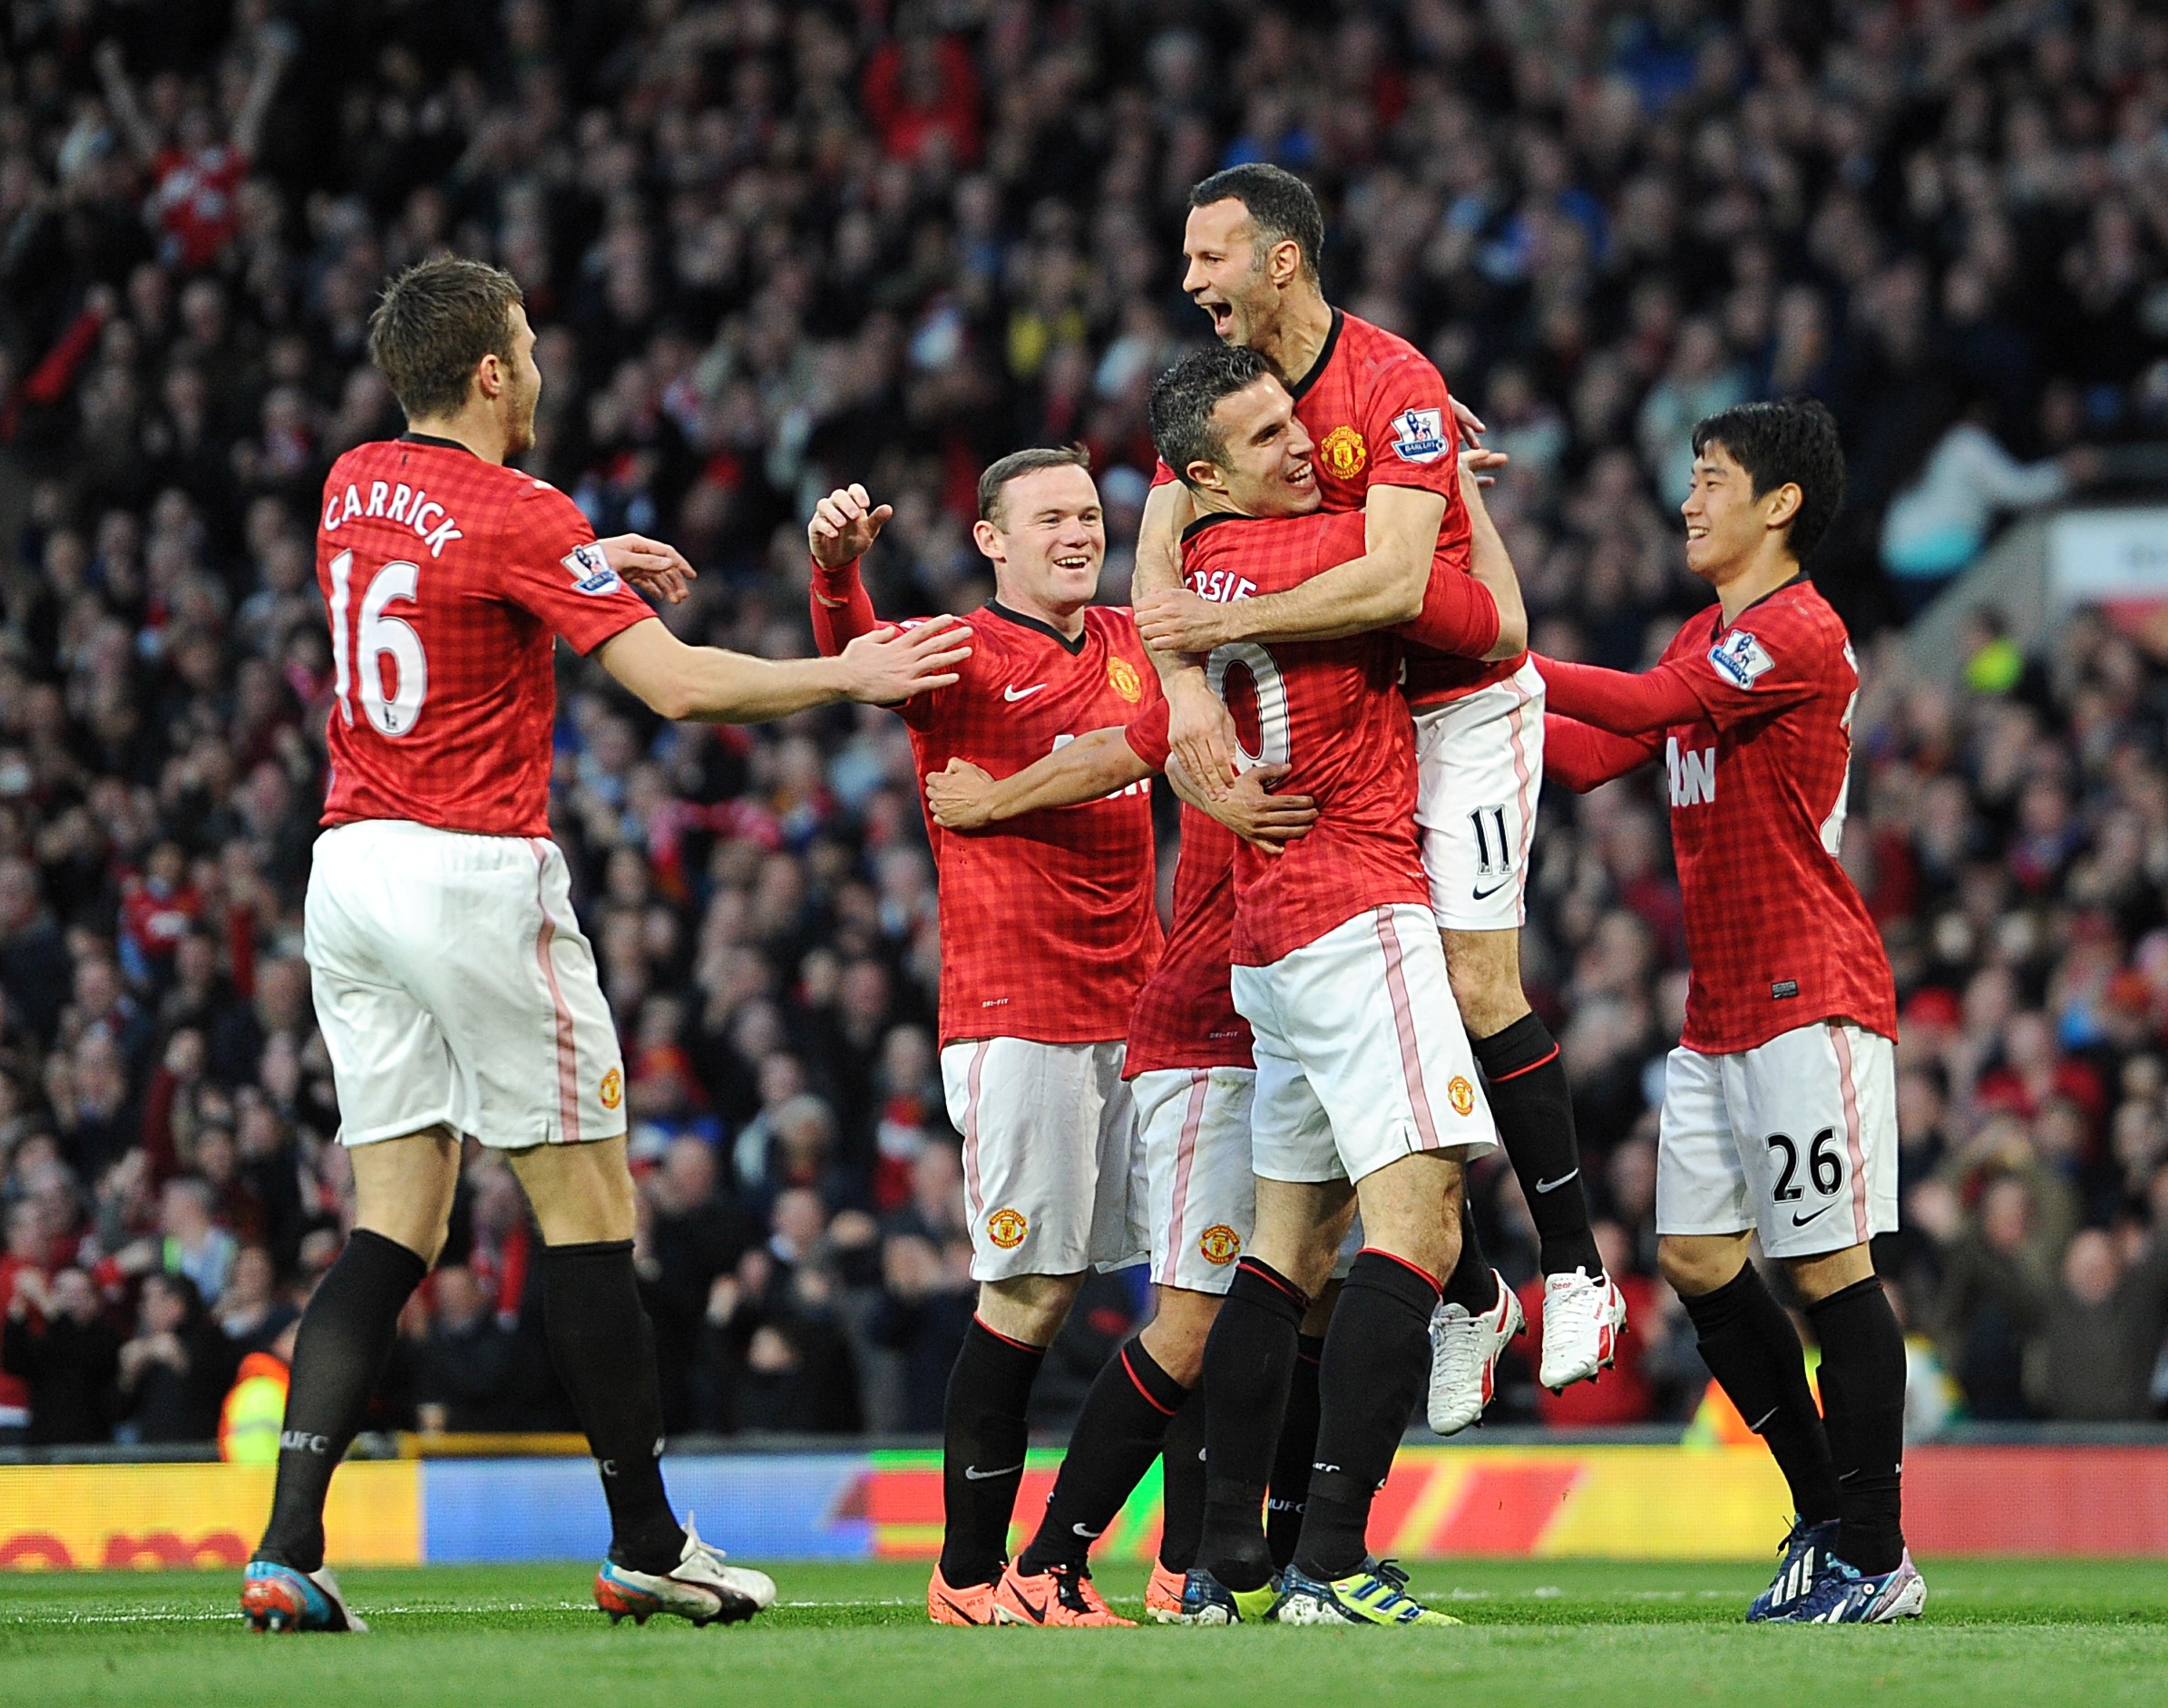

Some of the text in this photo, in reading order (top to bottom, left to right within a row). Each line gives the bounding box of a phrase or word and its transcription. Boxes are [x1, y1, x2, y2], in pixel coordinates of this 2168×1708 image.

[1332, 464, 1359, 475] UNITED
[324, 481, 463, 558] CARRICK
[328, 548, 427, 737] 16
[1467, 804, 1512, 876] 11
[1765, 1126, 1845, 1205] 26
